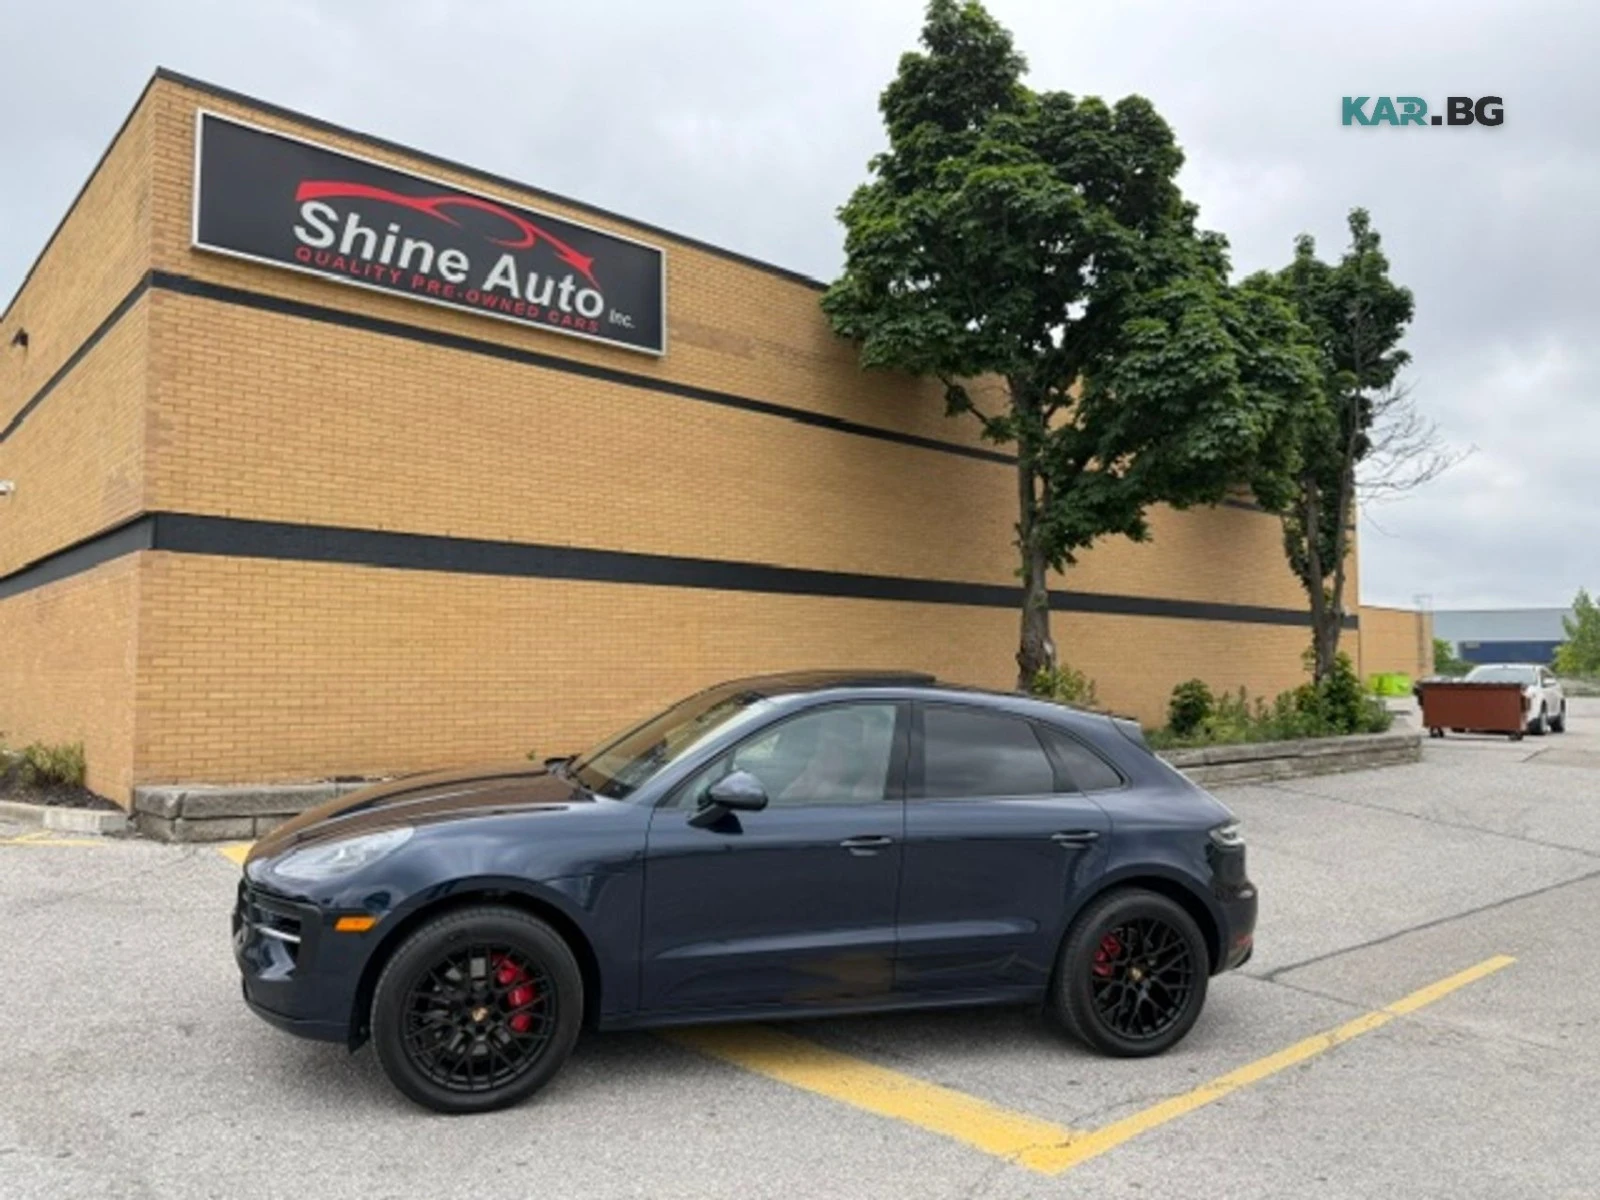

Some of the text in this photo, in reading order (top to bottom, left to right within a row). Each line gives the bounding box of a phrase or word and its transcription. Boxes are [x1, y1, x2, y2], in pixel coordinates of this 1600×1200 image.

[293, 201, 636, 329] Shine Auto Inc.
[295, 246, 600, 333] QUALITY PRE-OWNED CARS
